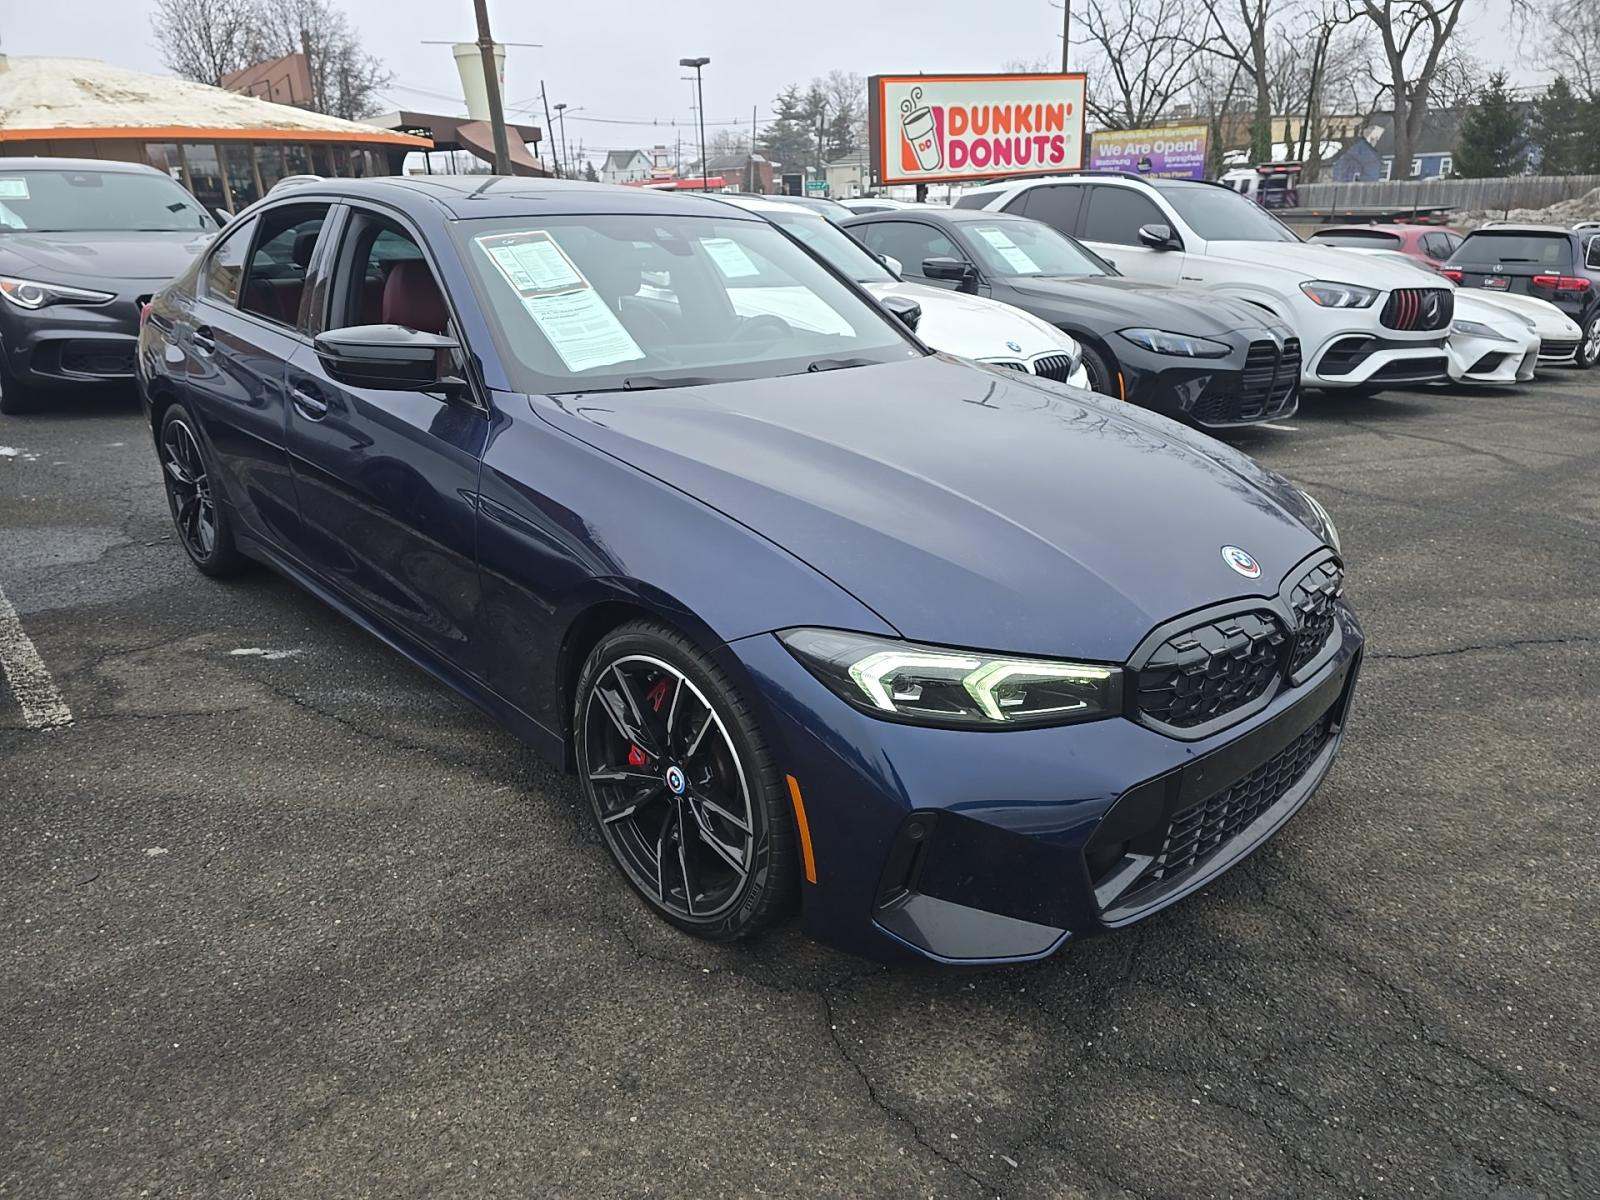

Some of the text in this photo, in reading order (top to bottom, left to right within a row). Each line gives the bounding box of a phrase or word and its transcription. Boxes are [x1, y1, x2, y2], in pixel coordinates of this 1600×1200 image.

[948, 103, 1073, 136] DUNKIN'
[919, 139, 932, 152] DD
[948, 134, 1065, 169] DONUTS
[1100, 139, 1198, 156] We Are Open!
